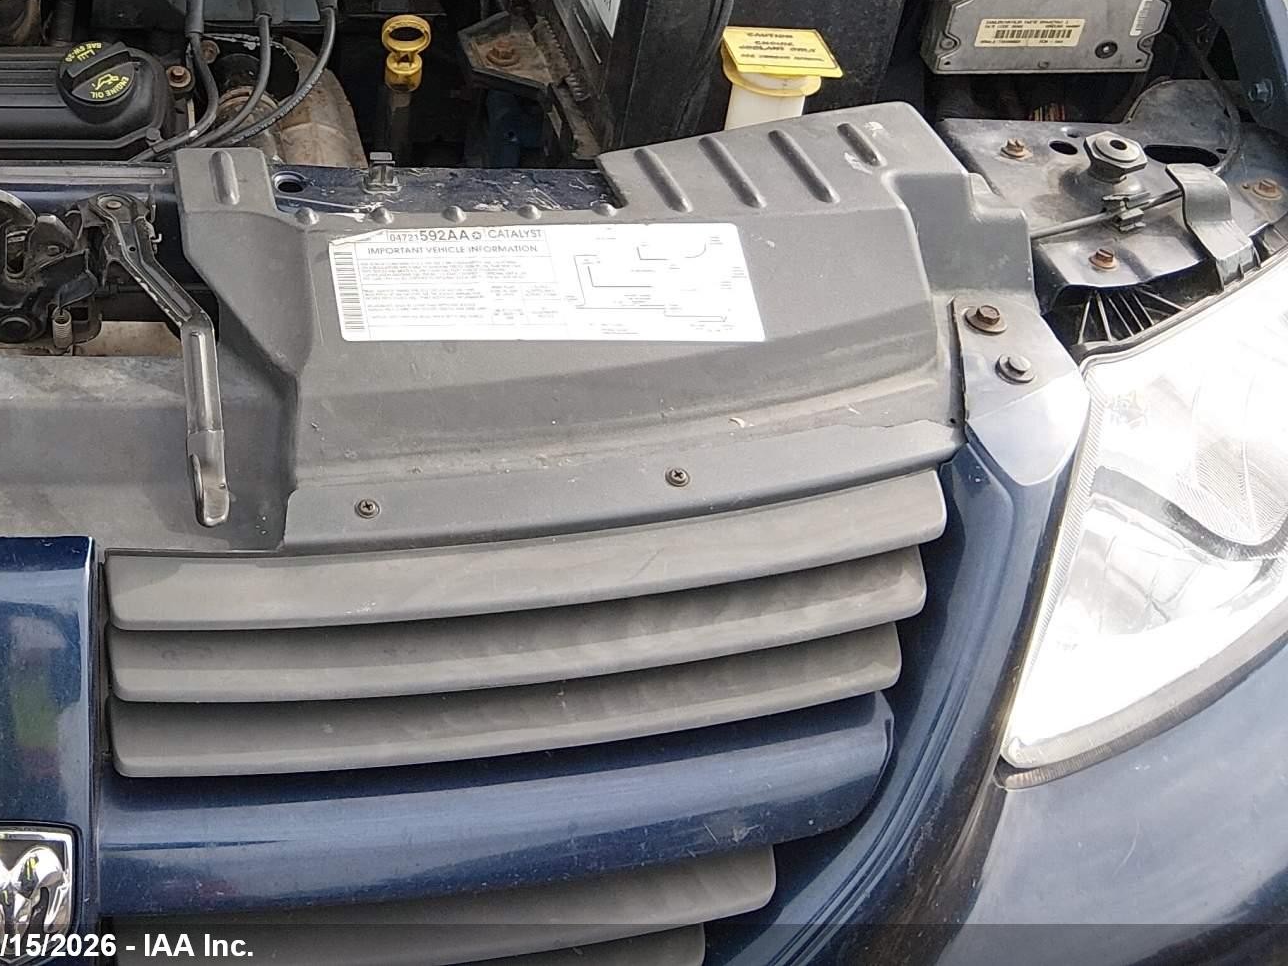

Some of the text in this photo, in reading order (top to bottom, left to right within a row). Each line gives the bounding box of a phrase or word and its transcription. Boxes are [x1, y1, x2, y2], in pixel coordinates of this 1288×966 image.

[90, 76, 130, 99] ENGINE OIL
[488, 229, 543, 239] CATALYST
[368, 245, 539, 255] IMPORTANT VEHICLE INFORMATION
